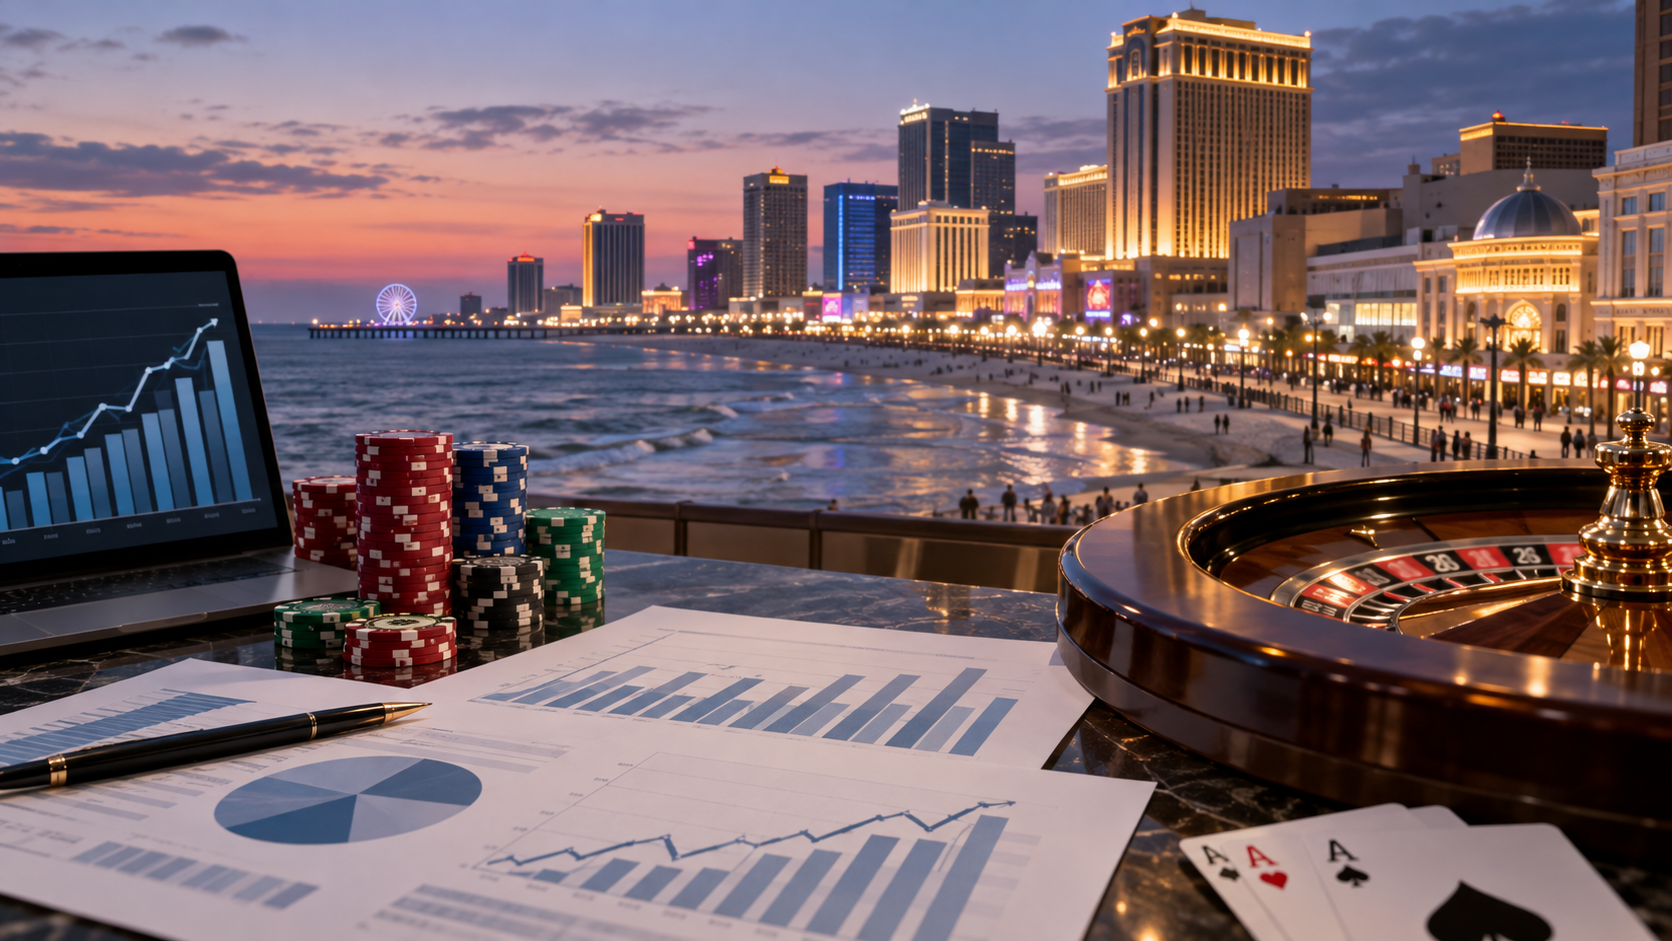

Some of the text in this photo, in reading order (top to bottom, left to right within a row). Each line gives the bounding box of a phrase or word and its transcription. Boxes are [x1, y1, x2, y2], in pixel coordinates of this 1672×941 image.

[1201, 844, 1230, 866] A
[1245, 844, 1280, 868] A
[1327, 838, 1360, 863] A
